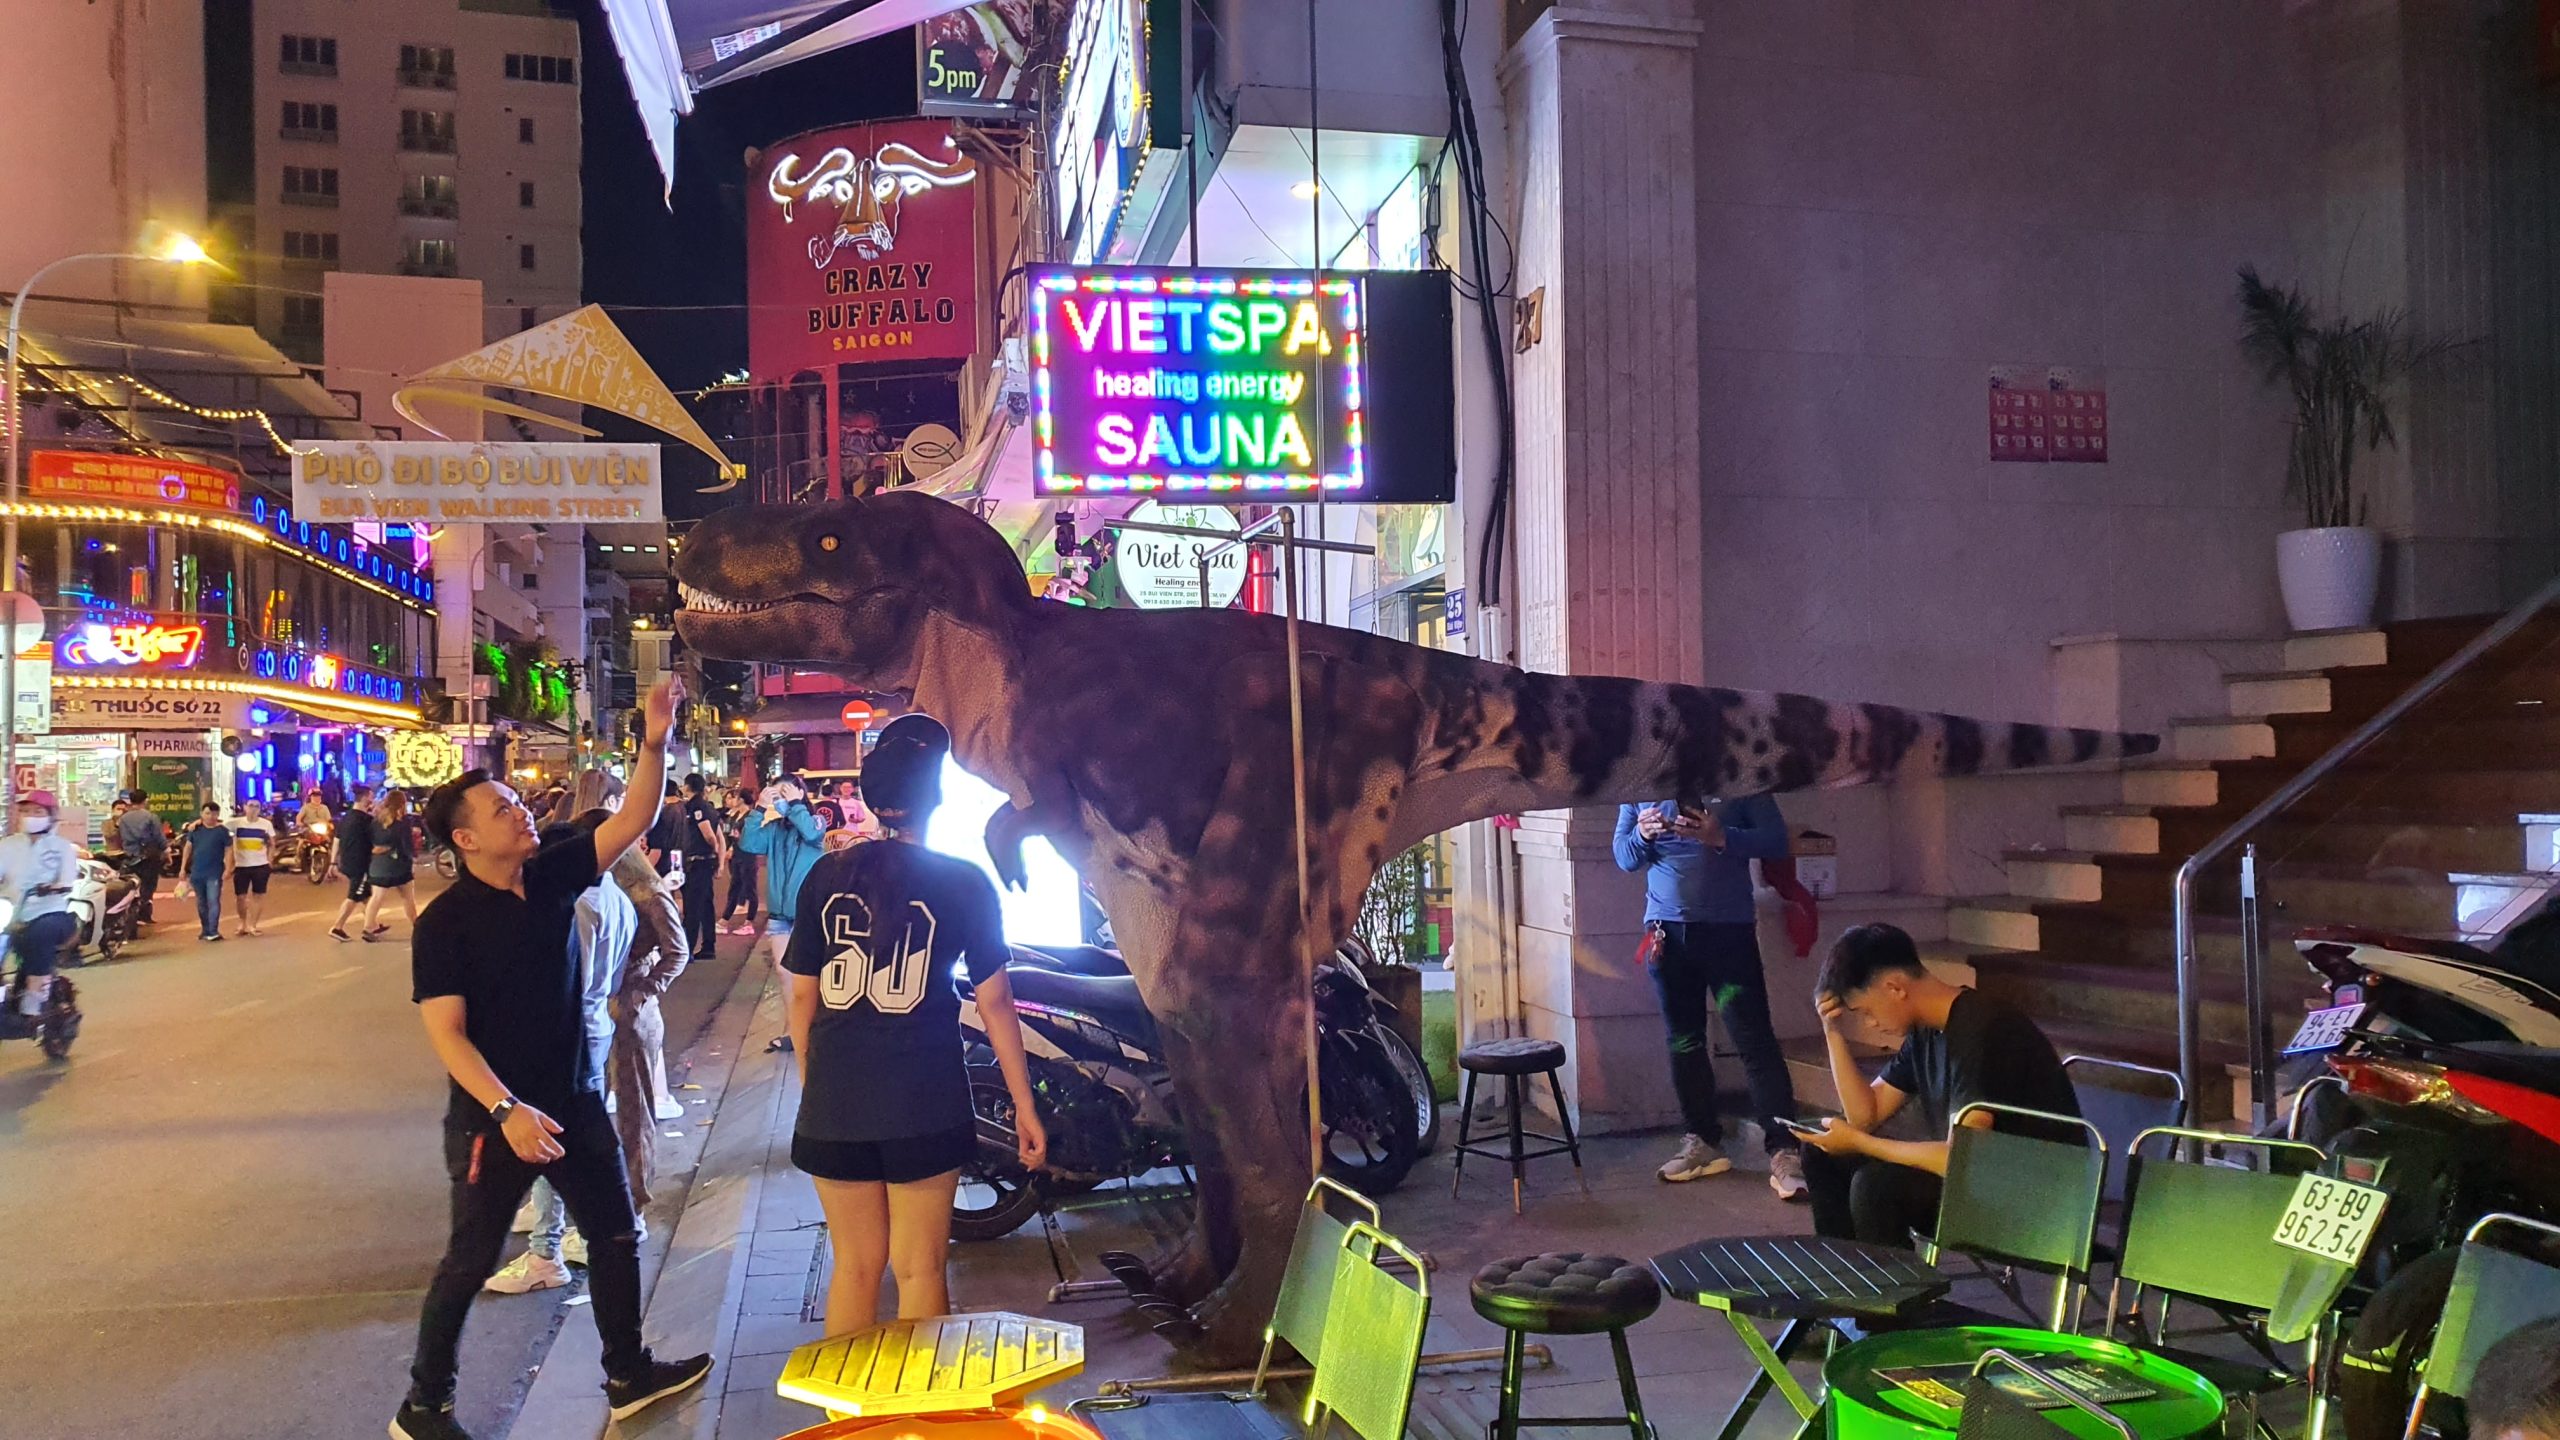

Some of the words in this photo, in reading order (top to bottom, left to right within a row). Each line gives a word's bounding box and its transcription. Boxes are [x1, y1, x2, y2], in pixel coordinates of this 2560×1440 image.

[928, 49, 977, 92] 5pm
[825, 262, 933, 296] CRAZY
[807, 298, 955, 334] BUFFALO
[1062, 299, 1332, 356] VIETSPA
[832, 330, 914, 352] SAIGON
[1094, 369, 1198, 404] healing
[1205, 371, 1305, 404] energy
[1095, 411, 1312, 468] SAUNA
[393, 454, 433, 485] ĐI
[440, 447, 492, 492] BỘ
[499, 446, 562, 485] BÙI
[569, 447, 651, 493] VIỆN
[319, 497, 365, 517] BUI
[438, 498, 551, 517] WALKING
[559, 498, 643, 517] STREET
[1127, 543, 1184, 569] Viet
[1155, 578, 1185, 587] Healing
[1446, 593, 1462, 619] 25
[91, 692, 169, 714] THUỐC
[203, 702, 221, 714] 22
[2307, 1008, 2355, 1030] 94-E1
[2303, 1180, 2371, 1221] 63-B9
[2279, 1210, 2362, 1259] 962.54
